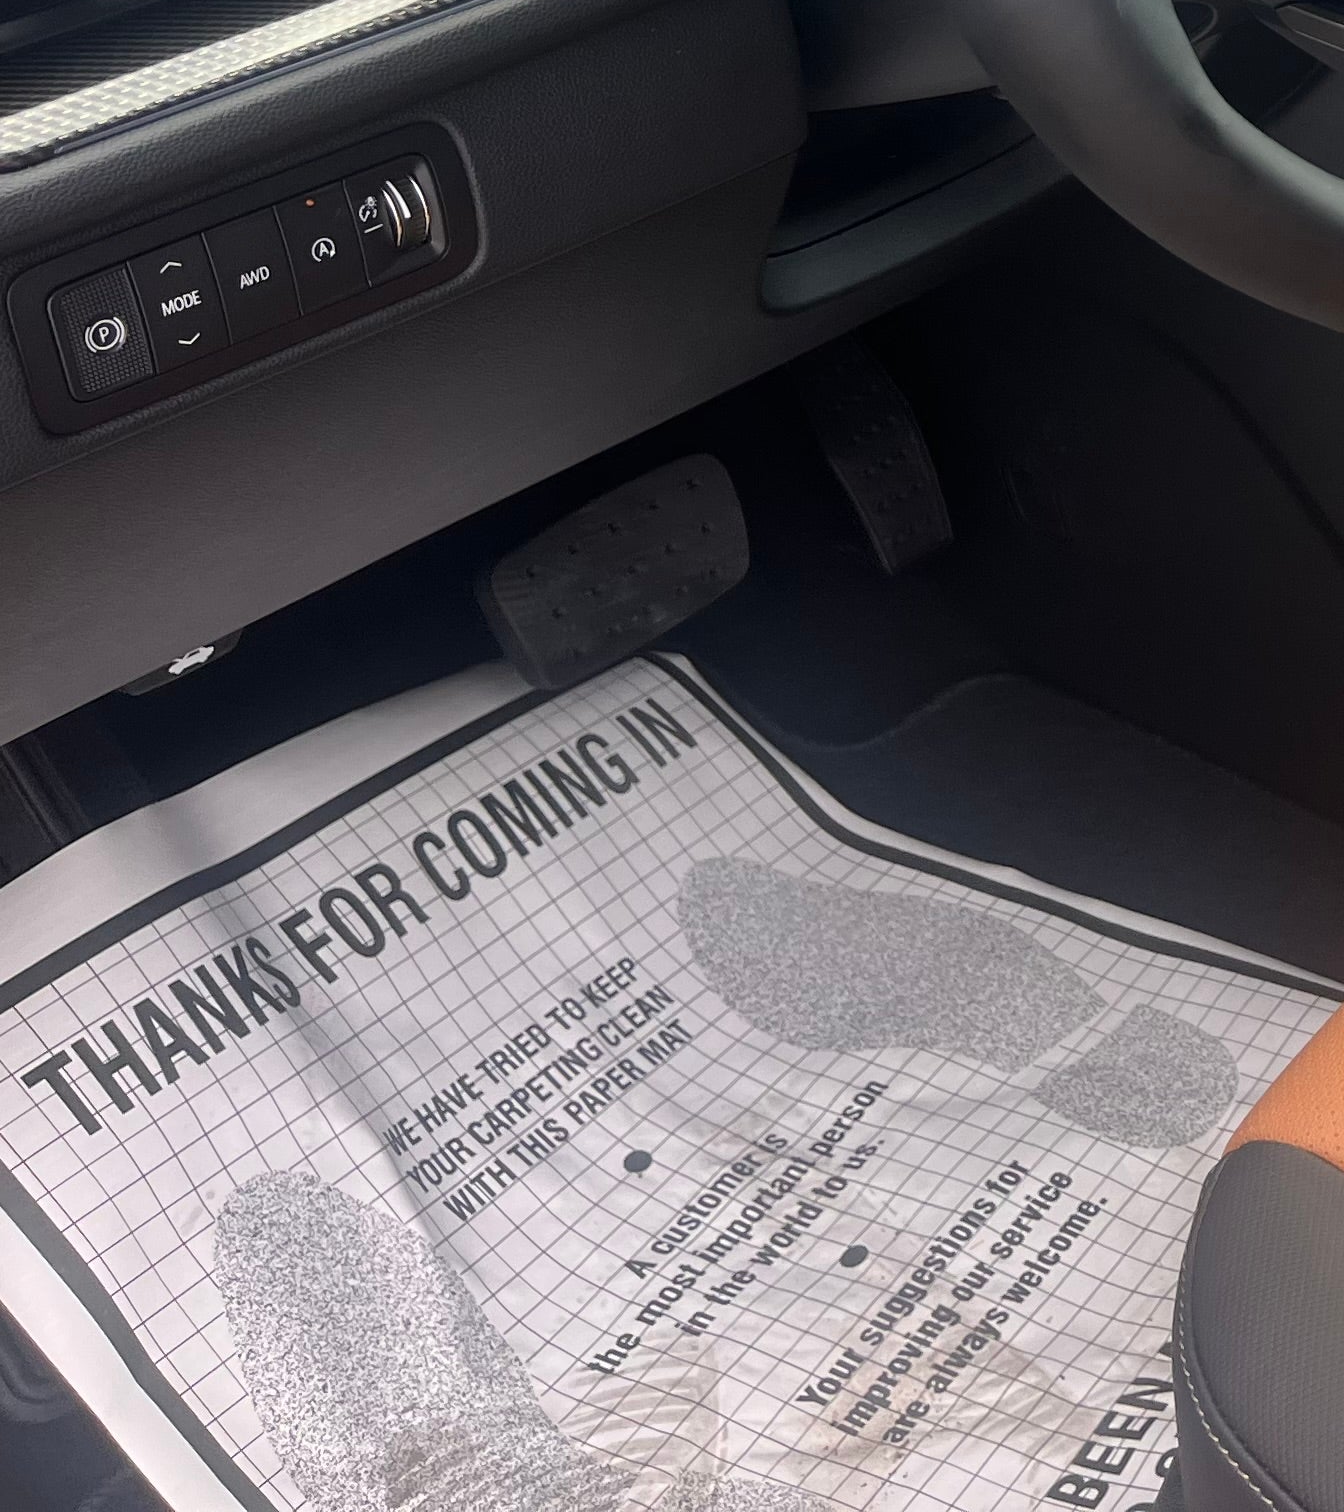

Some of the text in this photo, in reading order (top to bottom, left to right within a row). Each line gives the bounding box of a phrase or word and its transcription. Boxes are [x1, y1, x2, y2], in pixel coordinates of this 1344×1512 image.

[161, 290, 202, 317] MODE
[239, 265, 270, 290] AWD
[20, 698, 698, 1137] THANKS FOR COMING IN
[382, 956, 639, 1157] WE HAVE TRIED TO KEEP
[406, 984, 676, 1194] YOUR CARPETING CLEAN
[442, 1018, 694, 1223] WITH THIS PAPER MAT
[587, 1080, 889, 1376] the most important person
[623, 1132, 789, 1280] A customer is
[674, 1138, 886, 1338] in the world to us.
[796, 1159, 1032, 1407] Your suggestions for
[830, 1170, 1073, 1437] improving our service
[881, 1196, 1108, 1445] are always welcome.
[1046, 1376, 1174, 1511] BEEN
